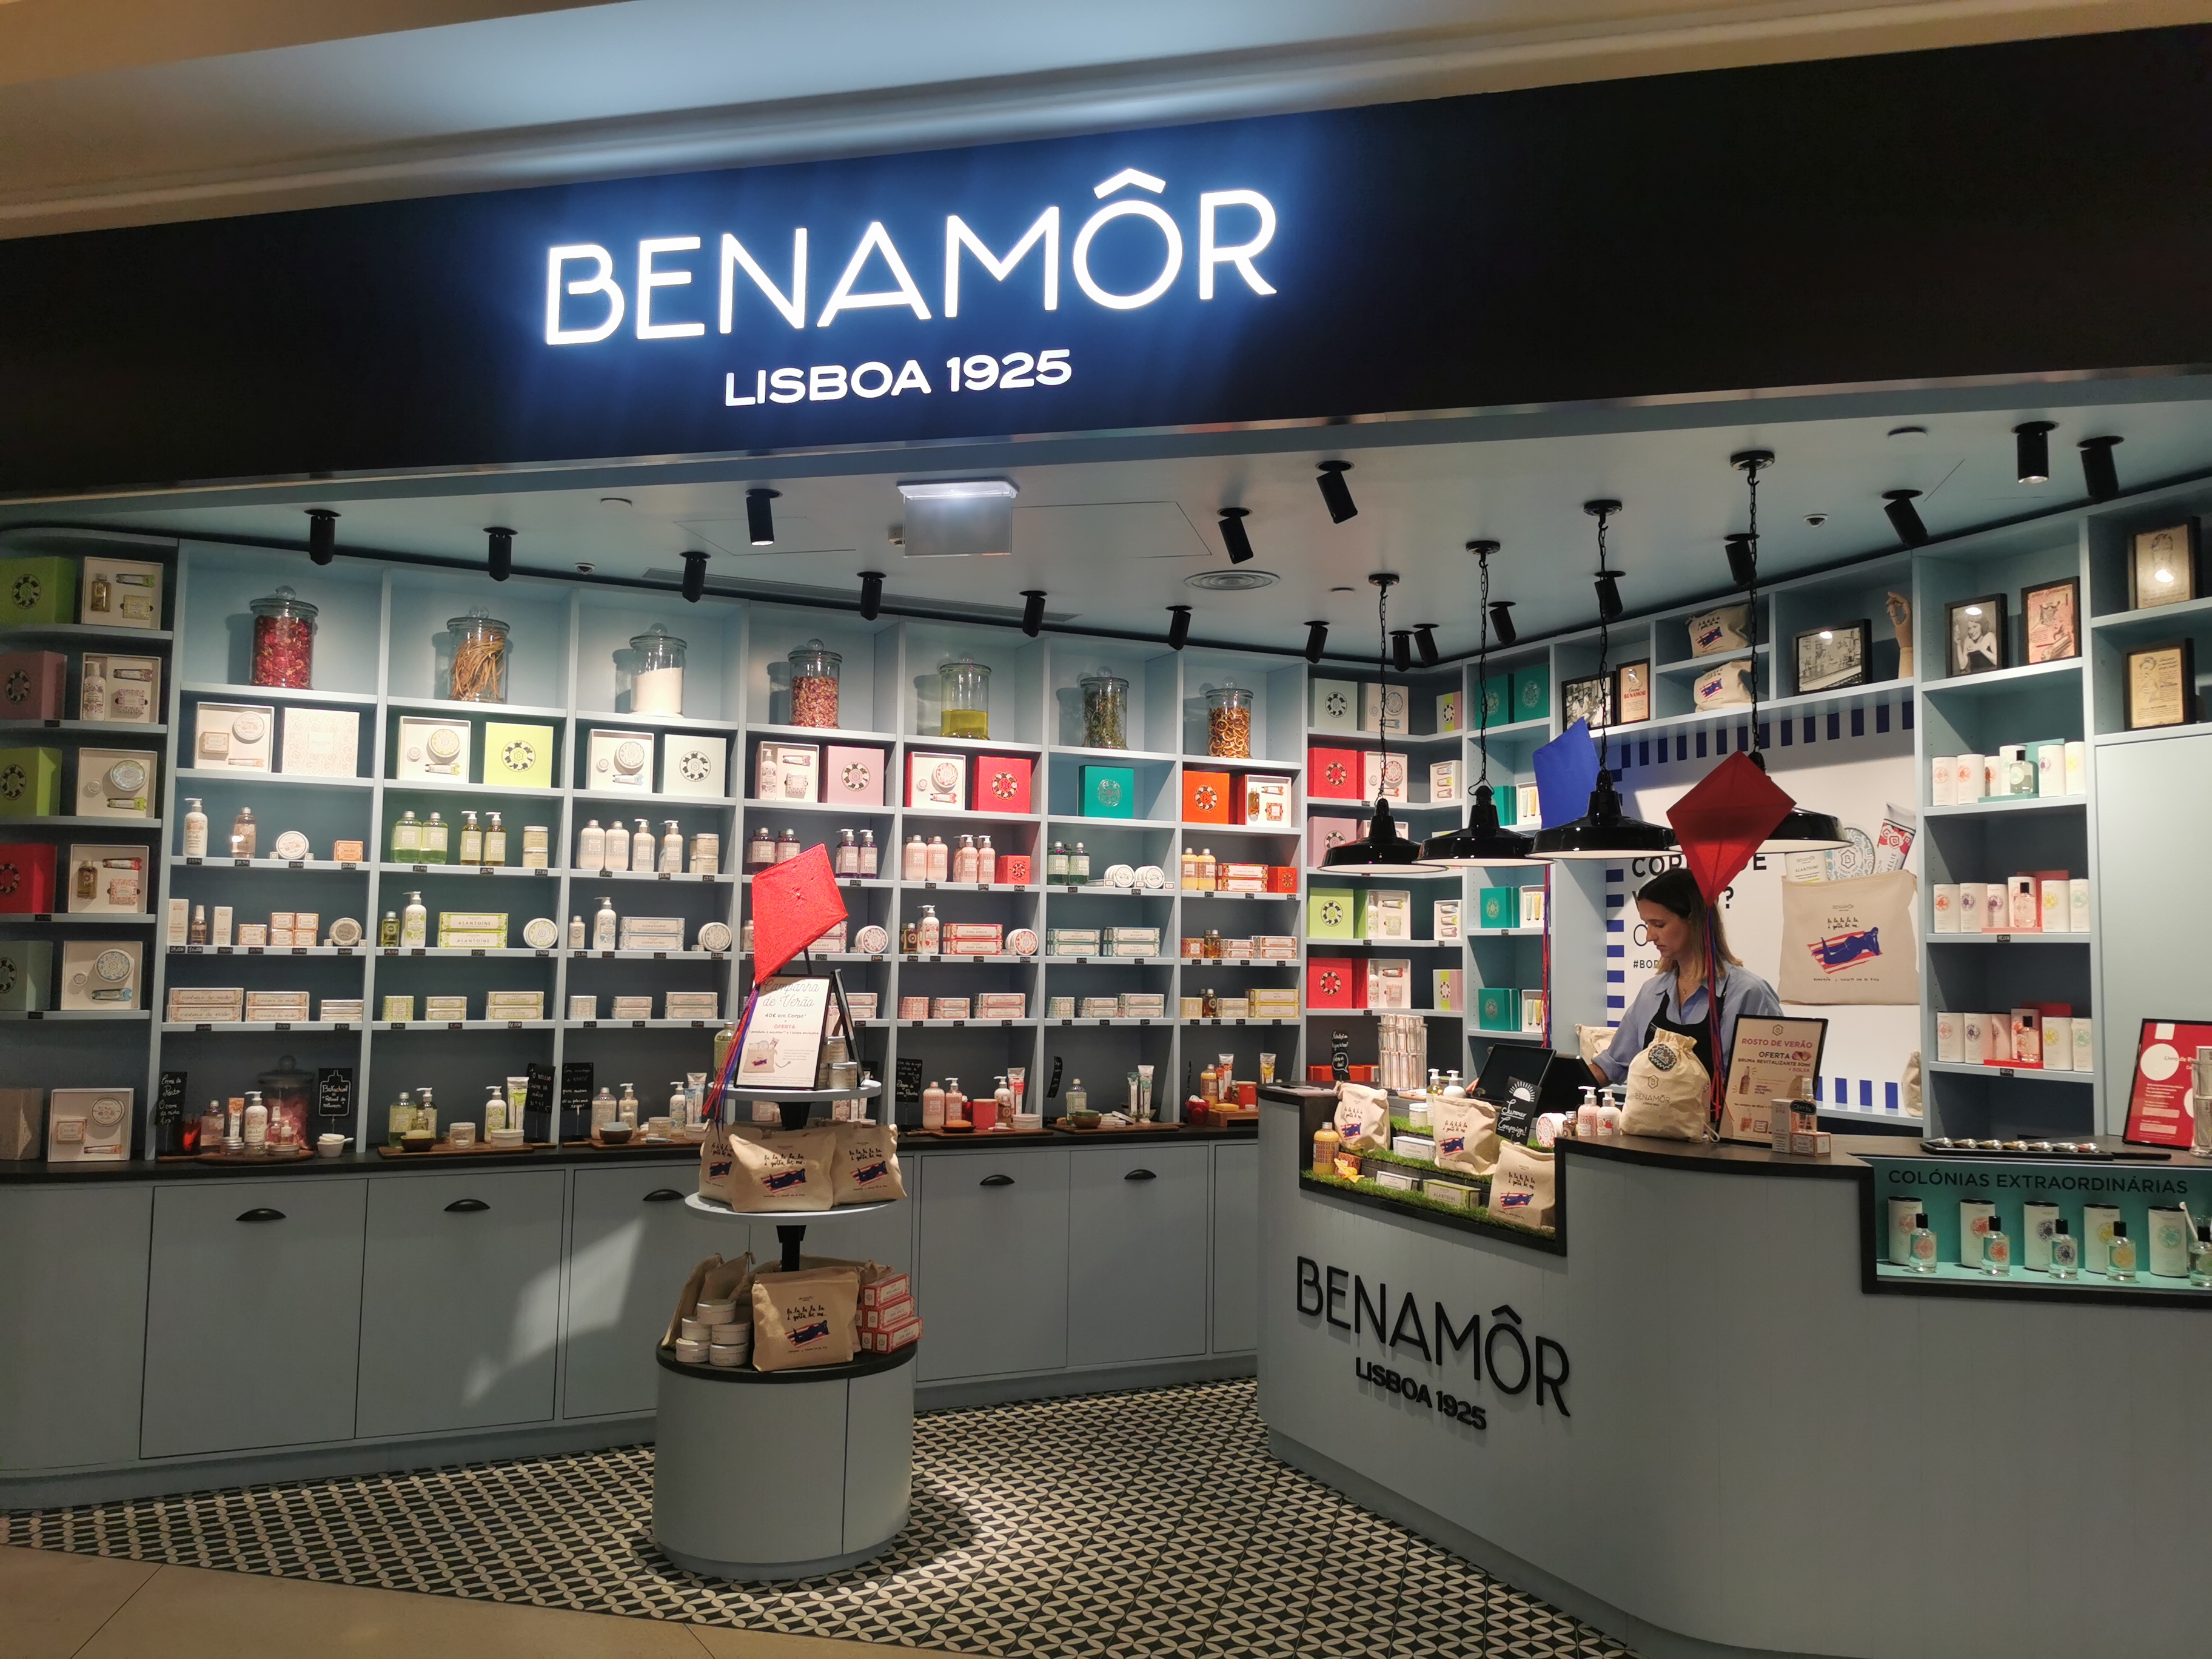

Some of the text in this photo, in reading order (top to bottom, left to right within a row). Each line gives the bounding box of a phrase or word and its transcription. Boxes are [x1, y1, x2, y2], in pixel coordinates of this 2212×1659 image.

[545, 169, 1277, 346] BENAMÔR
[725, 349, 1072, 407] LISBOA 1925
[764, 979, 819, 994] Campanha
[762, 994, 814, 1007] de Verão
[1741, 1038, 1769, 1047] ROSTO
[1785, 1038, 1813, 1048] VERÃO
[1635, 1093, 1671, 1103] BENAMÔR
[1888, 1168, 2188, 1195] COLÓNIAS EXTRAORDINÁRIAS
[1297, 1256, 1570, 1417] BENAMÔR
[1356, 1356, 1487, 1430] LISBOA 1925
